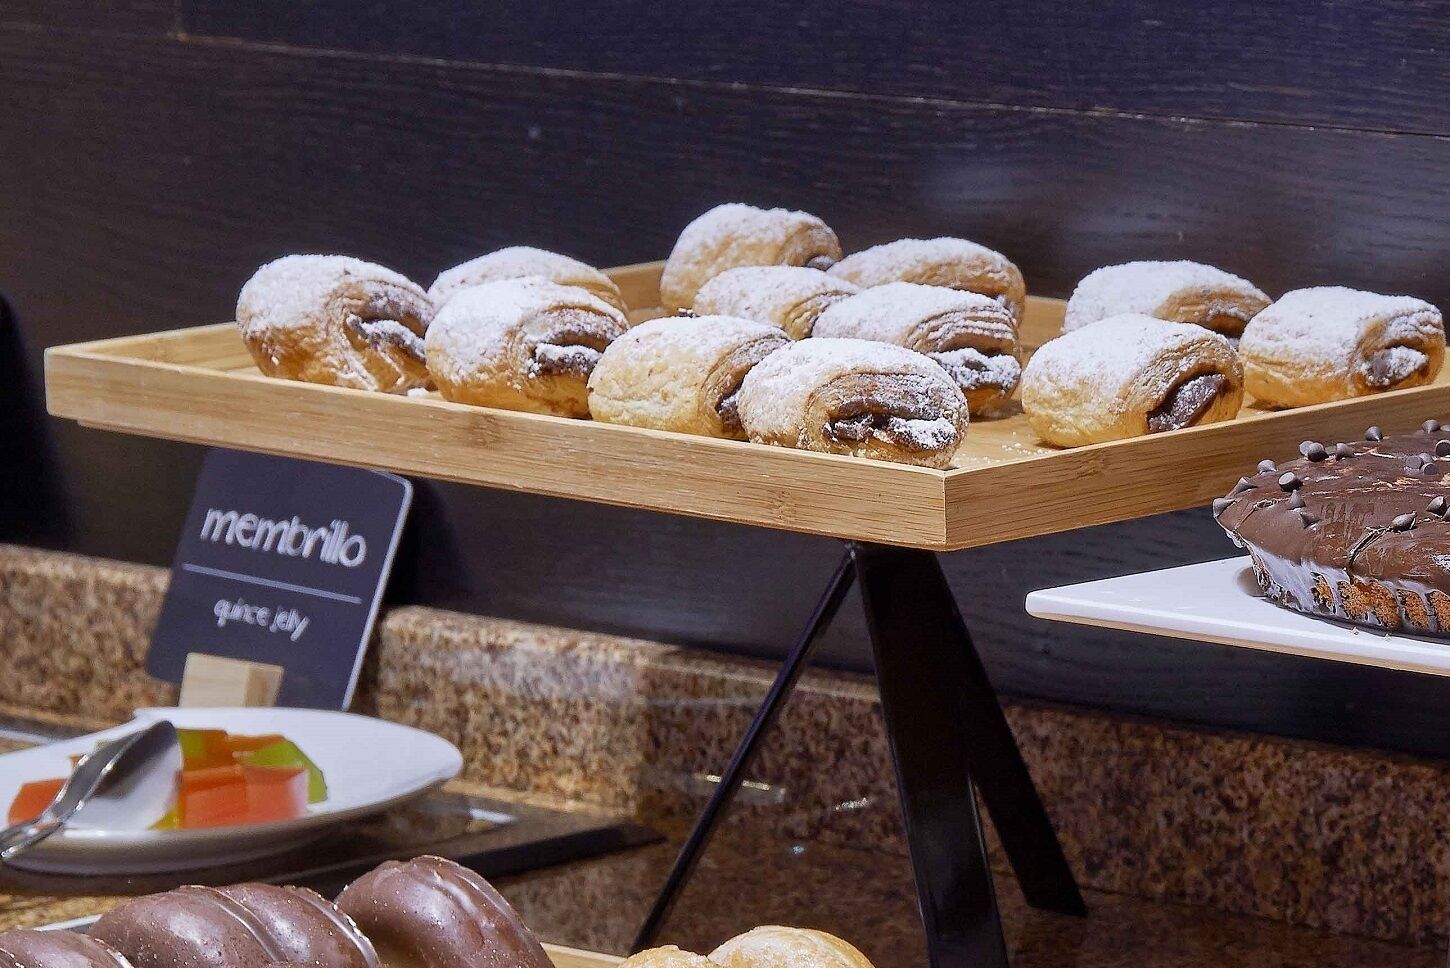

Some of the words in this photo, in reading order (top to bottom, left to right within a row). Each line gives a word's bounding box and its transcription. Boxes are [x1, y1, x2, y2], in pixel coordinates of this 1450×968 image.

[201, 509, 366, 567] membrillo
[214, 598, 271, 629] quince
[271, 606, 309, 641] jelly
